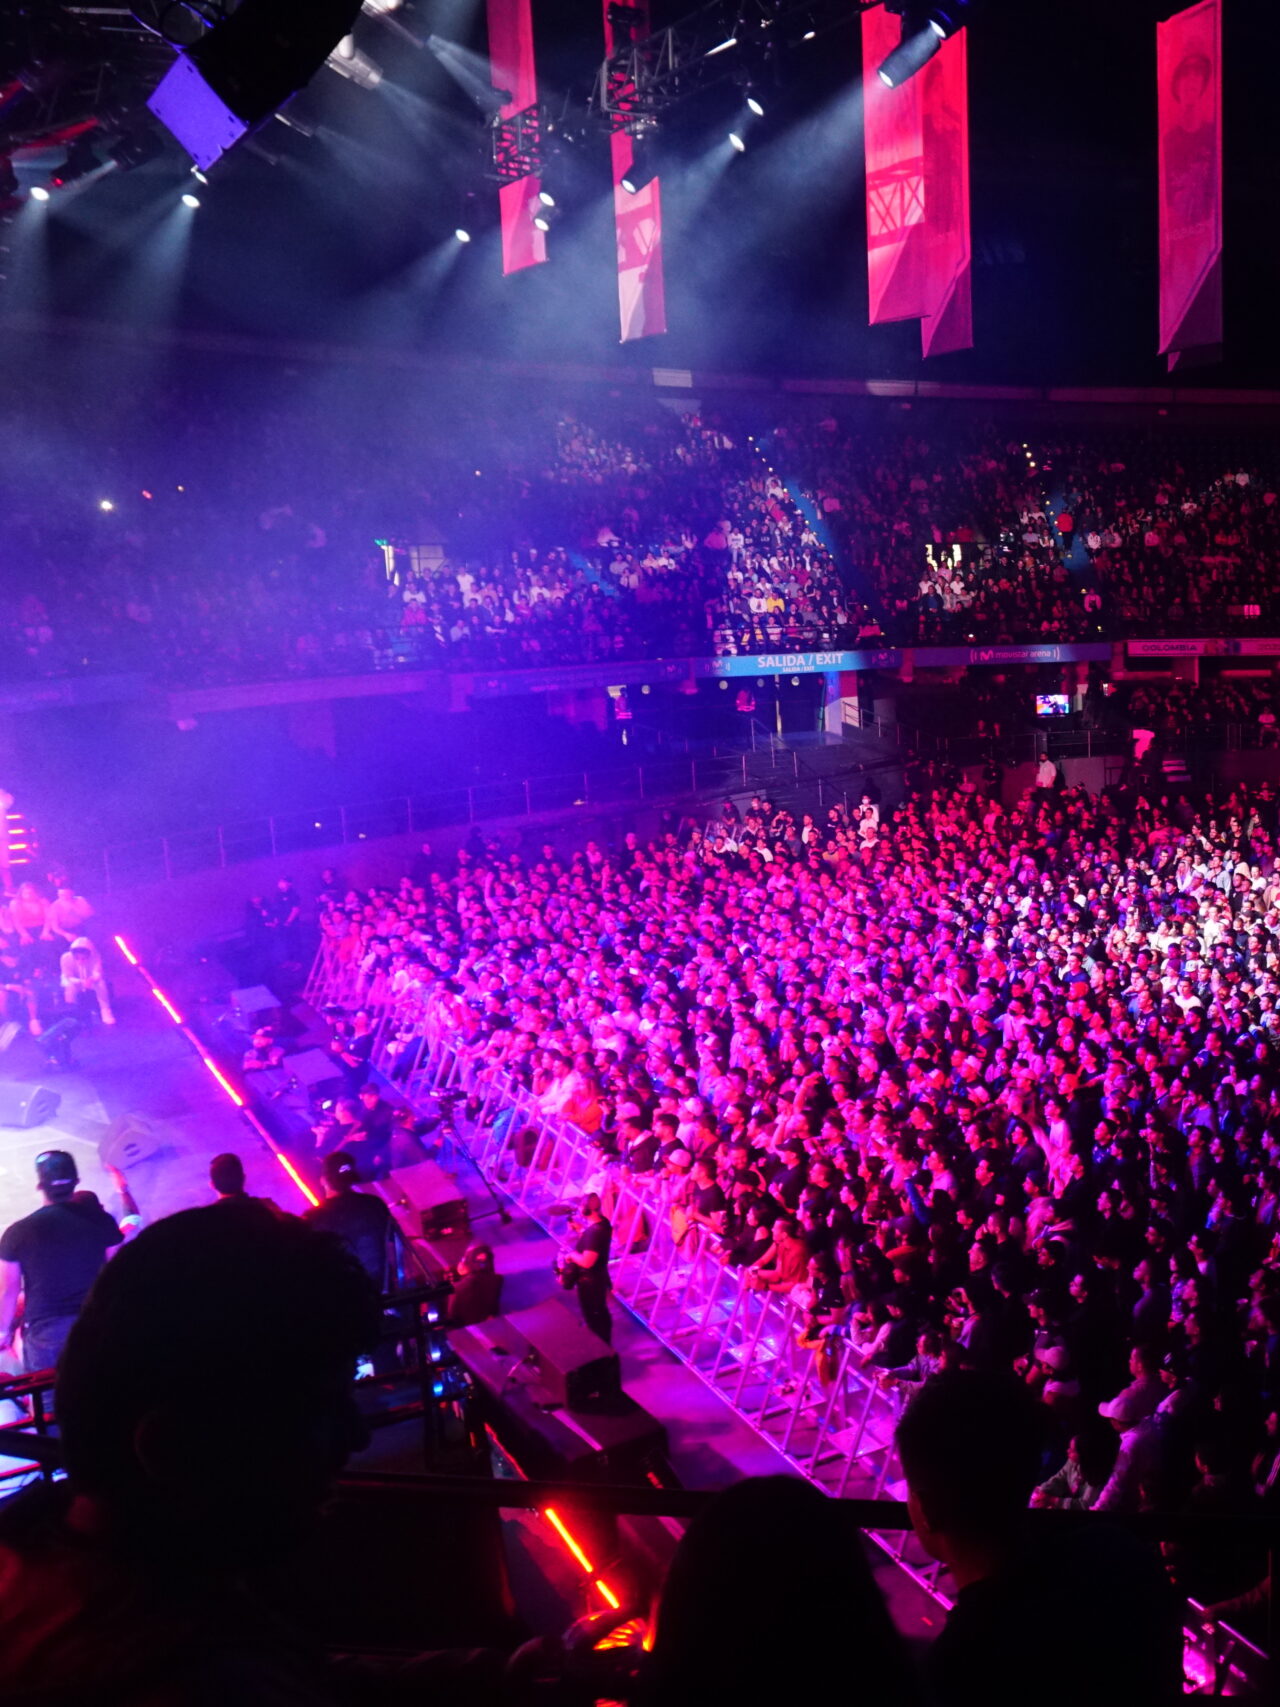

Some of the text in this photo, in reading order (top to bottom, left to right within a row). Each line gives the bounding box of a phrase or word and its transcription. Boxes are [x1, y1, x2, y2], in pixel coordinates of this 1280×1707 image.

[1142, 644, 1197, 652] COLOMBIA
[995, 651, 1028, 659] movistar
[1029, 650, 1051, 658] arena
[757, 655, 805, 668] SALIDA
[816, 653, 844, 665] EXIT
